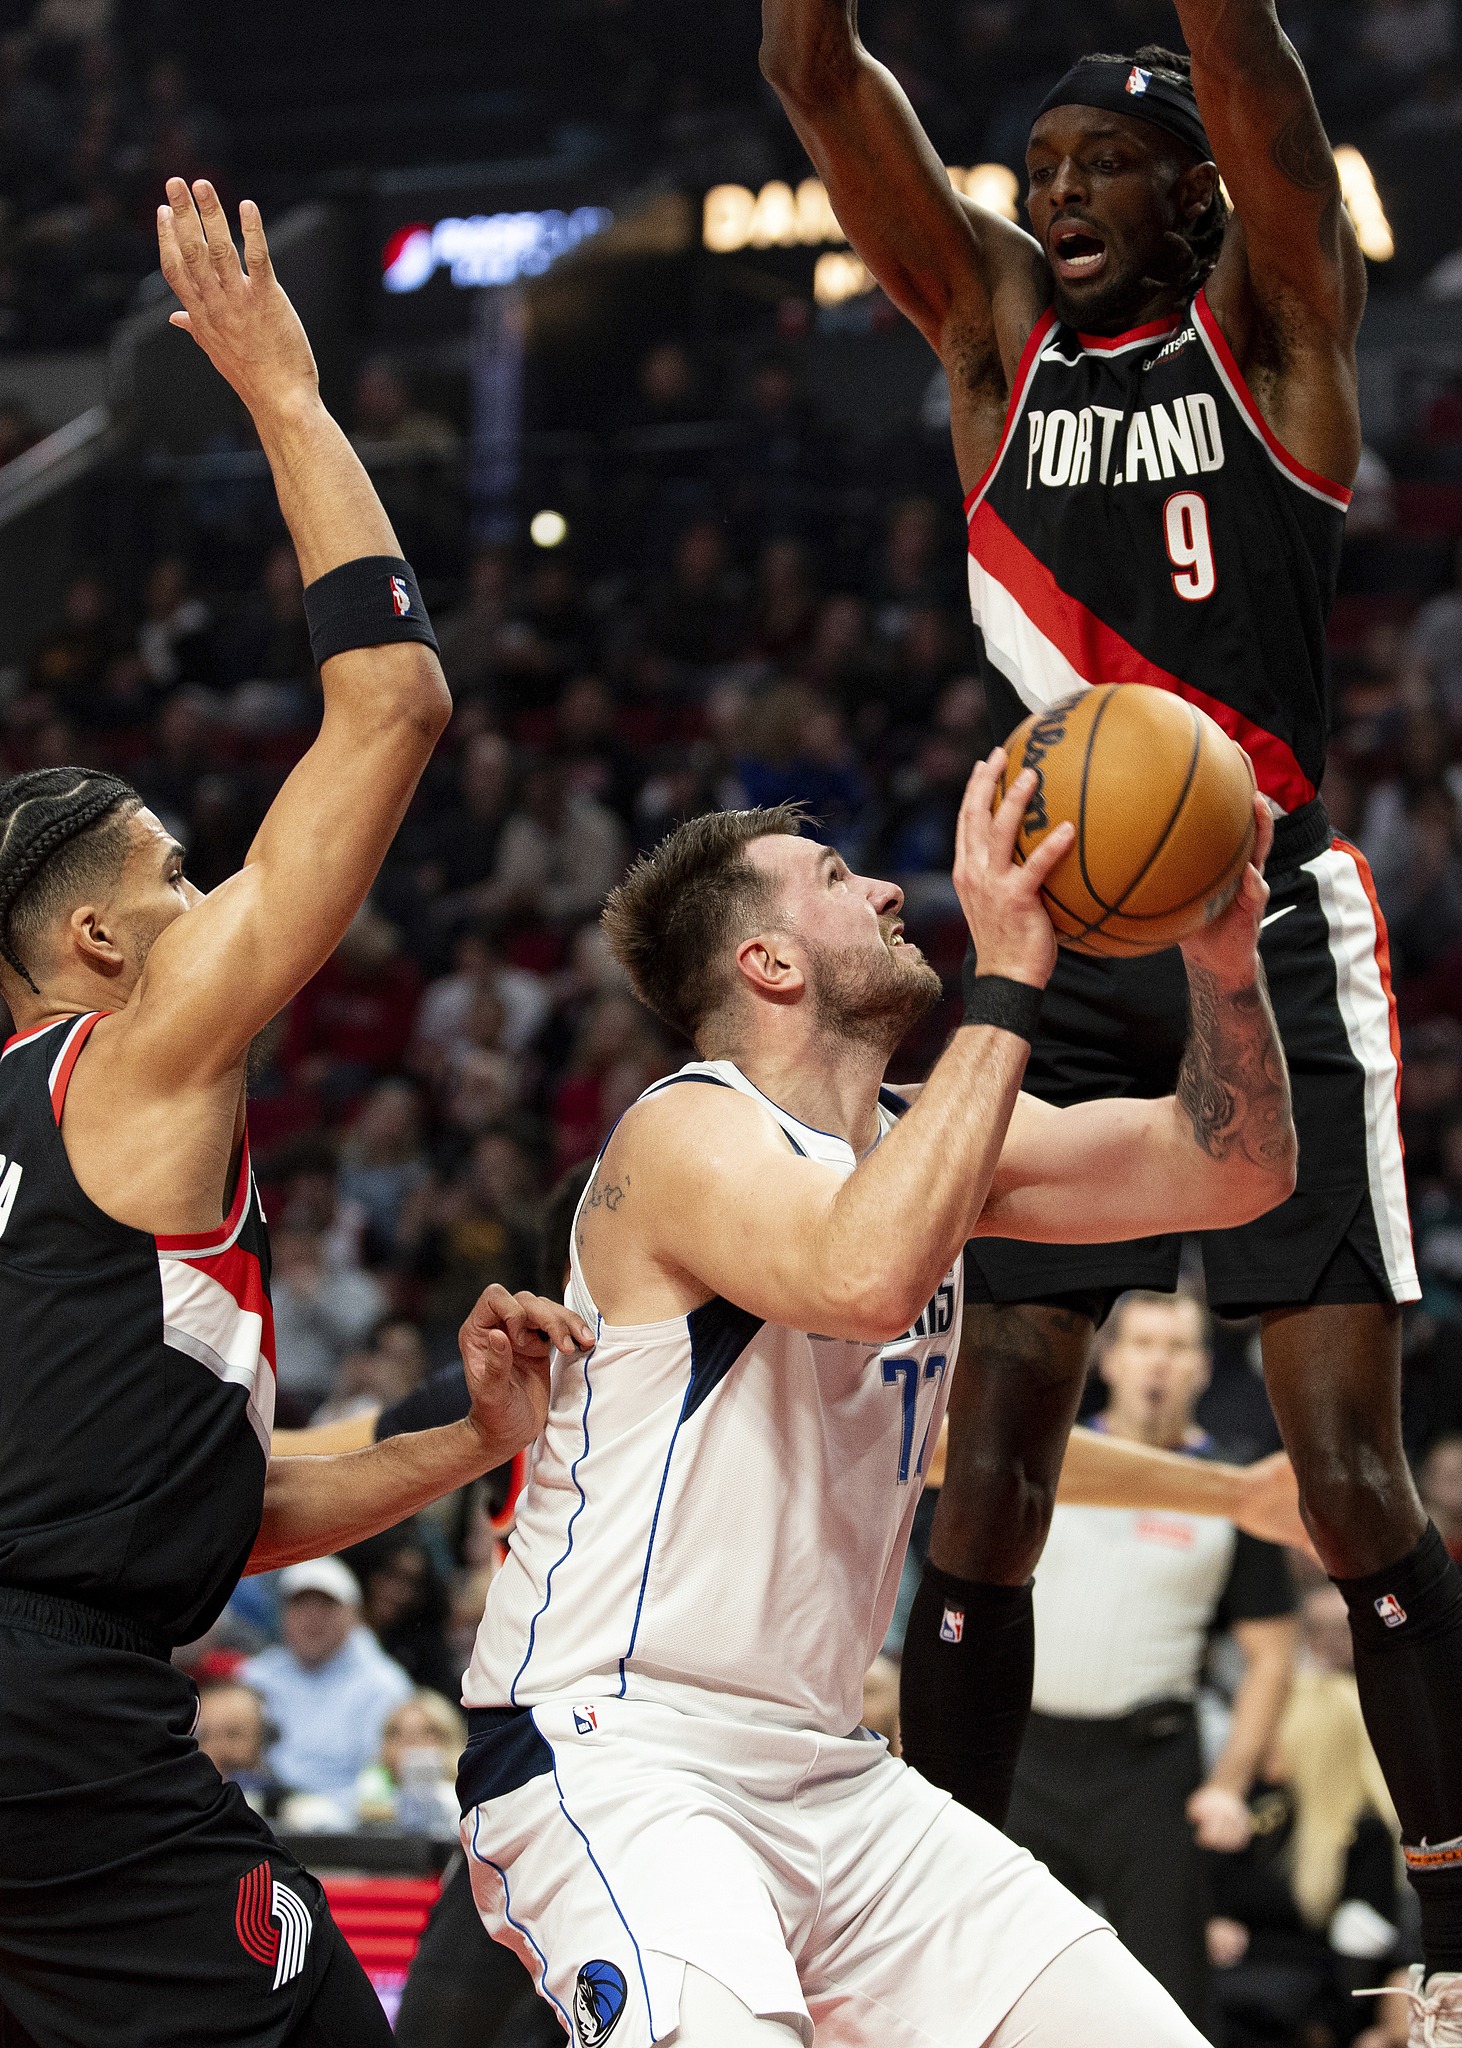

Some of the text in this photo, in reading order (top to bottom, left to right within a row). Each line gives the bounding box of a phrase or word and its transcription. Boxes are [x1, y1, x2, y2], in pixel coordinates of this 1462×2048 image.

[1026, 393, 1225, 490] PORTAND
[1163, 490, 1217, 602] 9
[880, 1352, 947, 1485] 77
